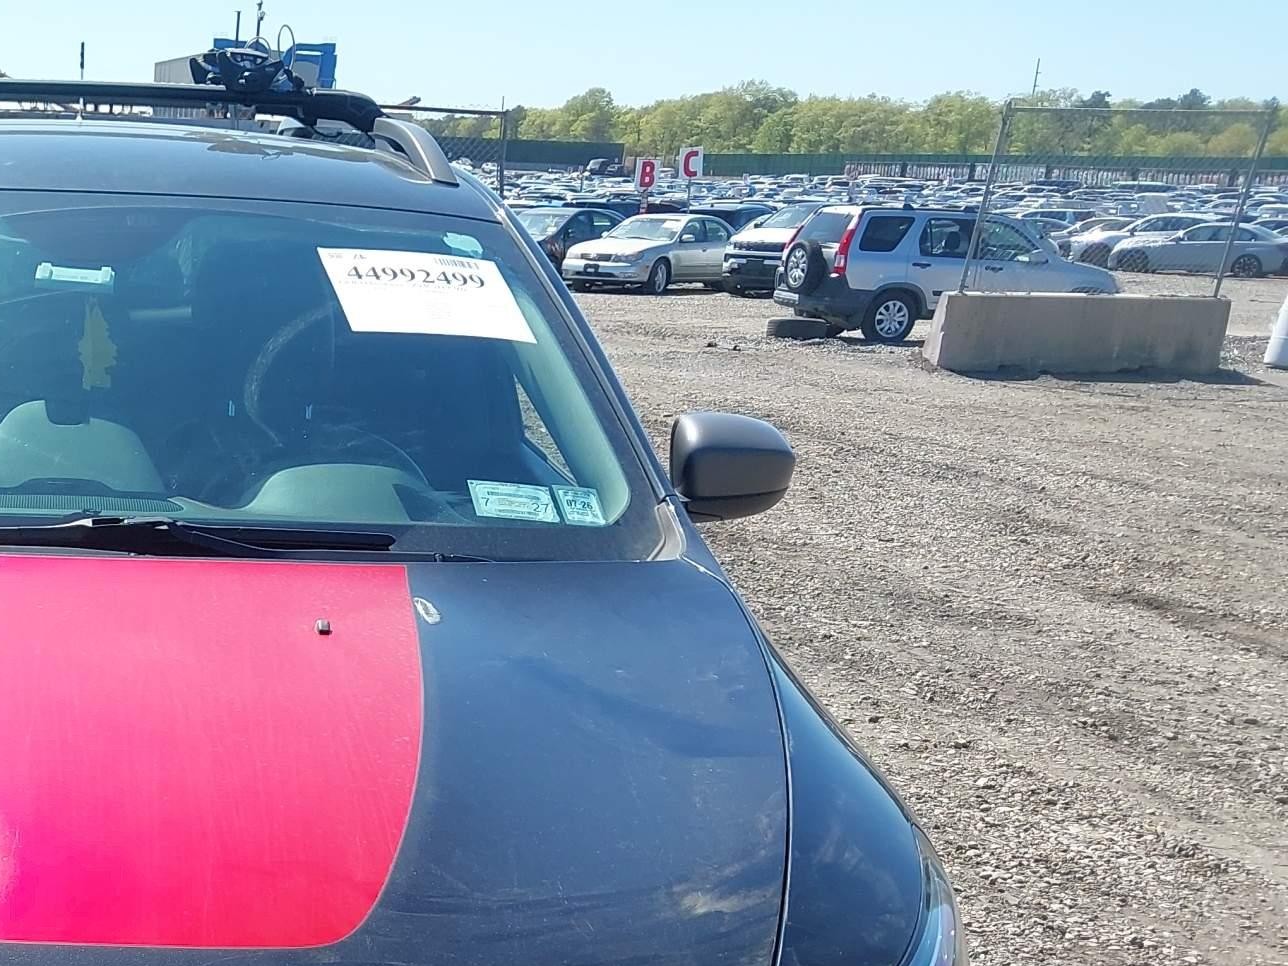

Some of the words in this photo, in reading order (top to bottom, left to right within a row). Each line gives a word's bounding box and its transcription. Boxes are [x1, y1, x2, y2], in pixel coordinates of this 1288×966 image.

[639, 160, 655, 188] B
[684, 150, 699, 177] C
[347, 264, 485, 289] 44992499
[532, 502, 549, 513] 27
